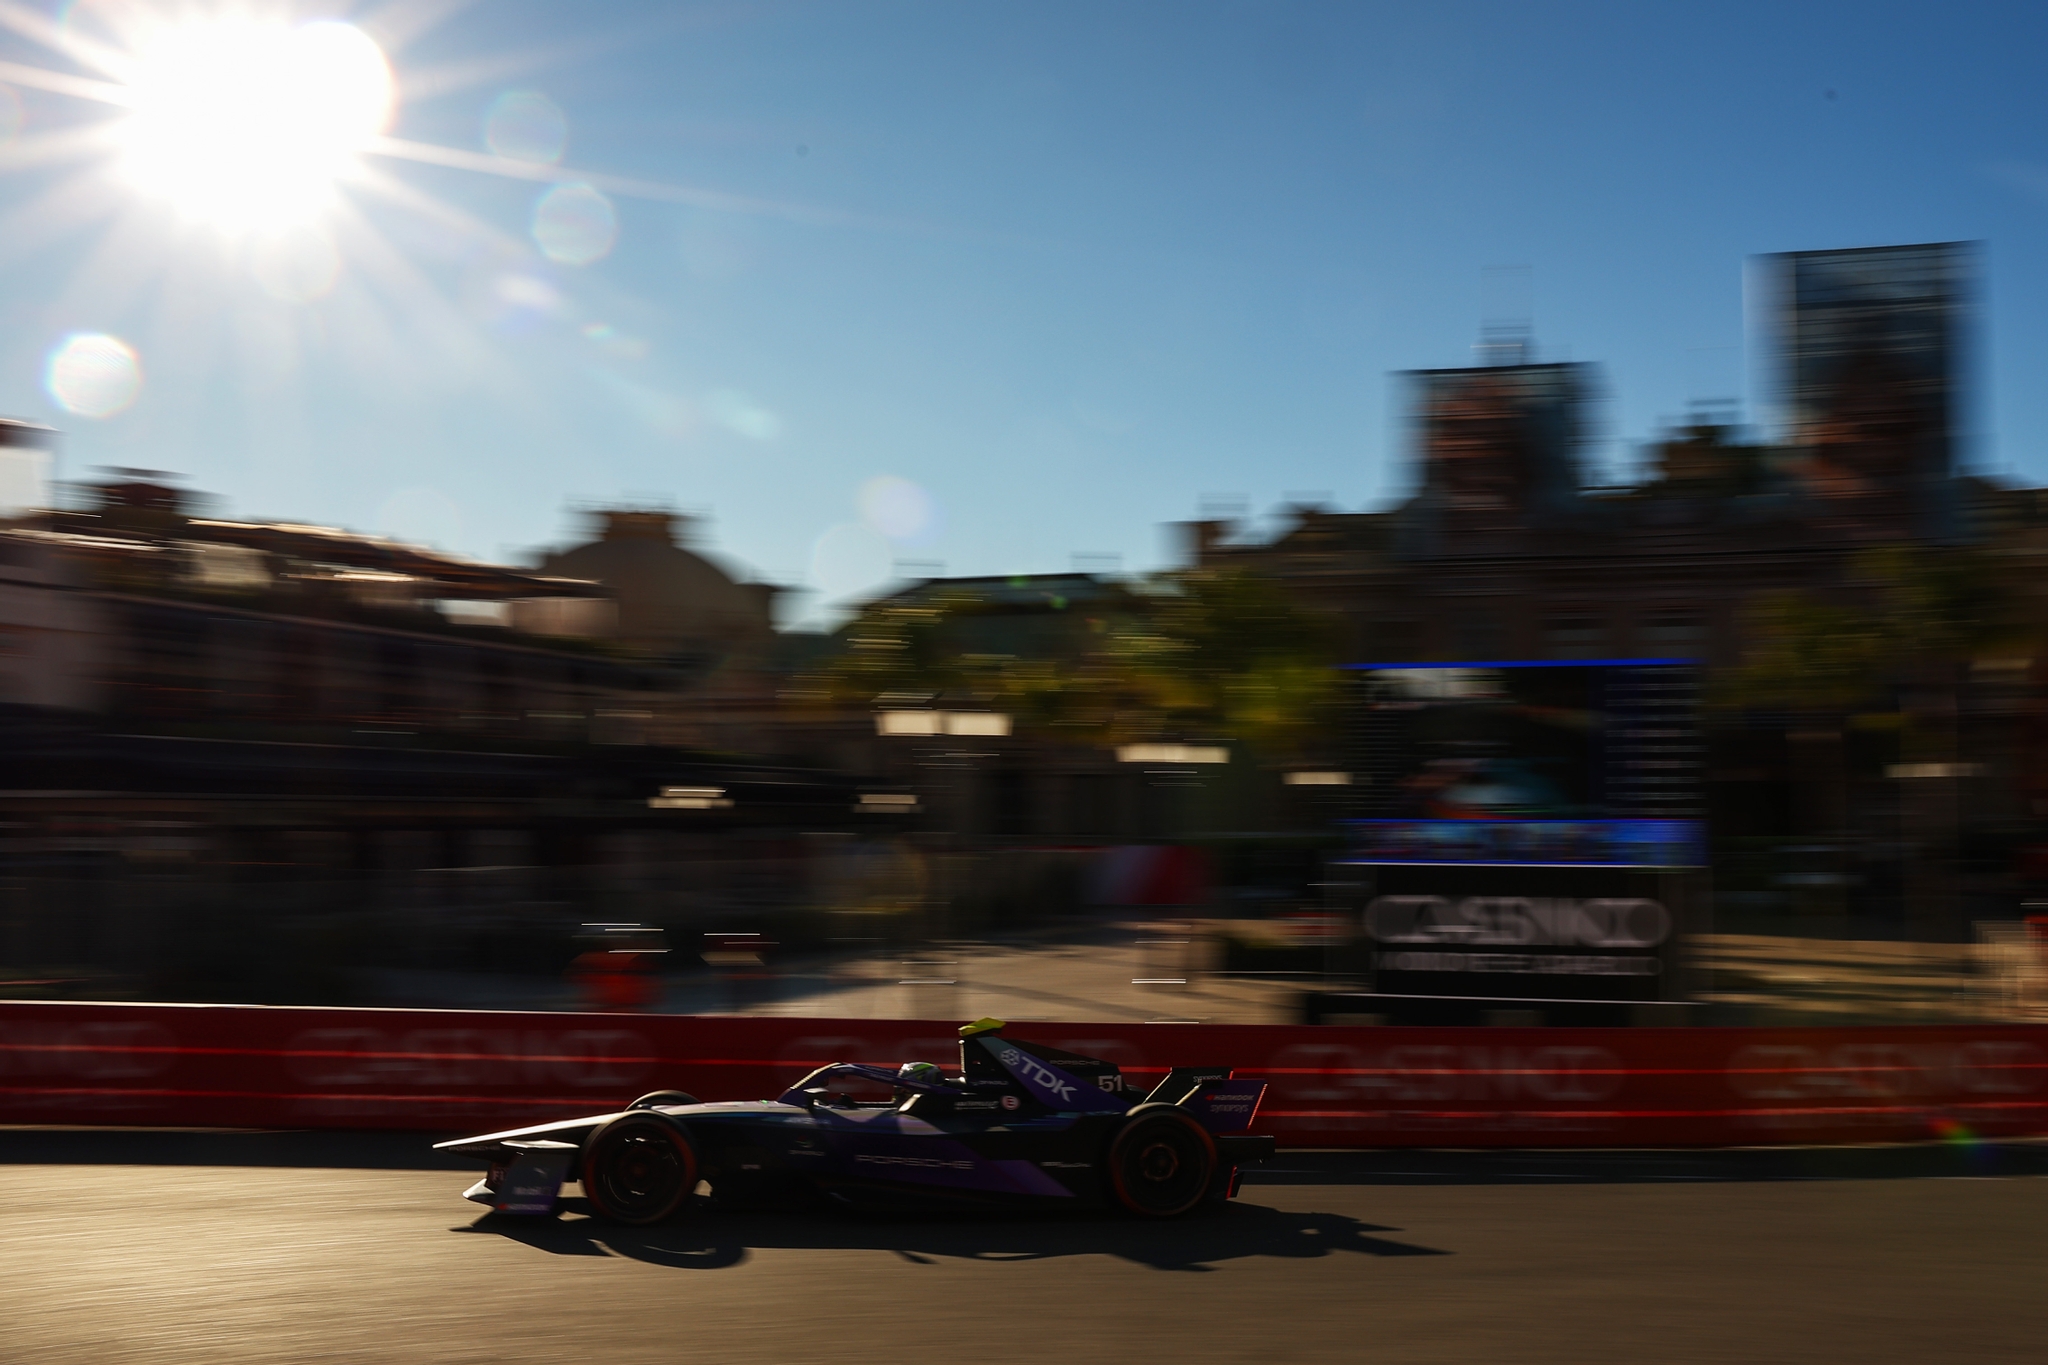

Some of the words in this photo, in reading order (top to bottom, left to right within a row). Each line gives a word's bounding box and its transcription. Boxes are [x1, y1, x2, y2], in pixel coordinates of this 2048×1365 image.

[1020, 1056, 1078, 1102] TDK
[1098, 1075, 1122, 1093] 51
[854, 1154, 975, 1170] PORSCHE
